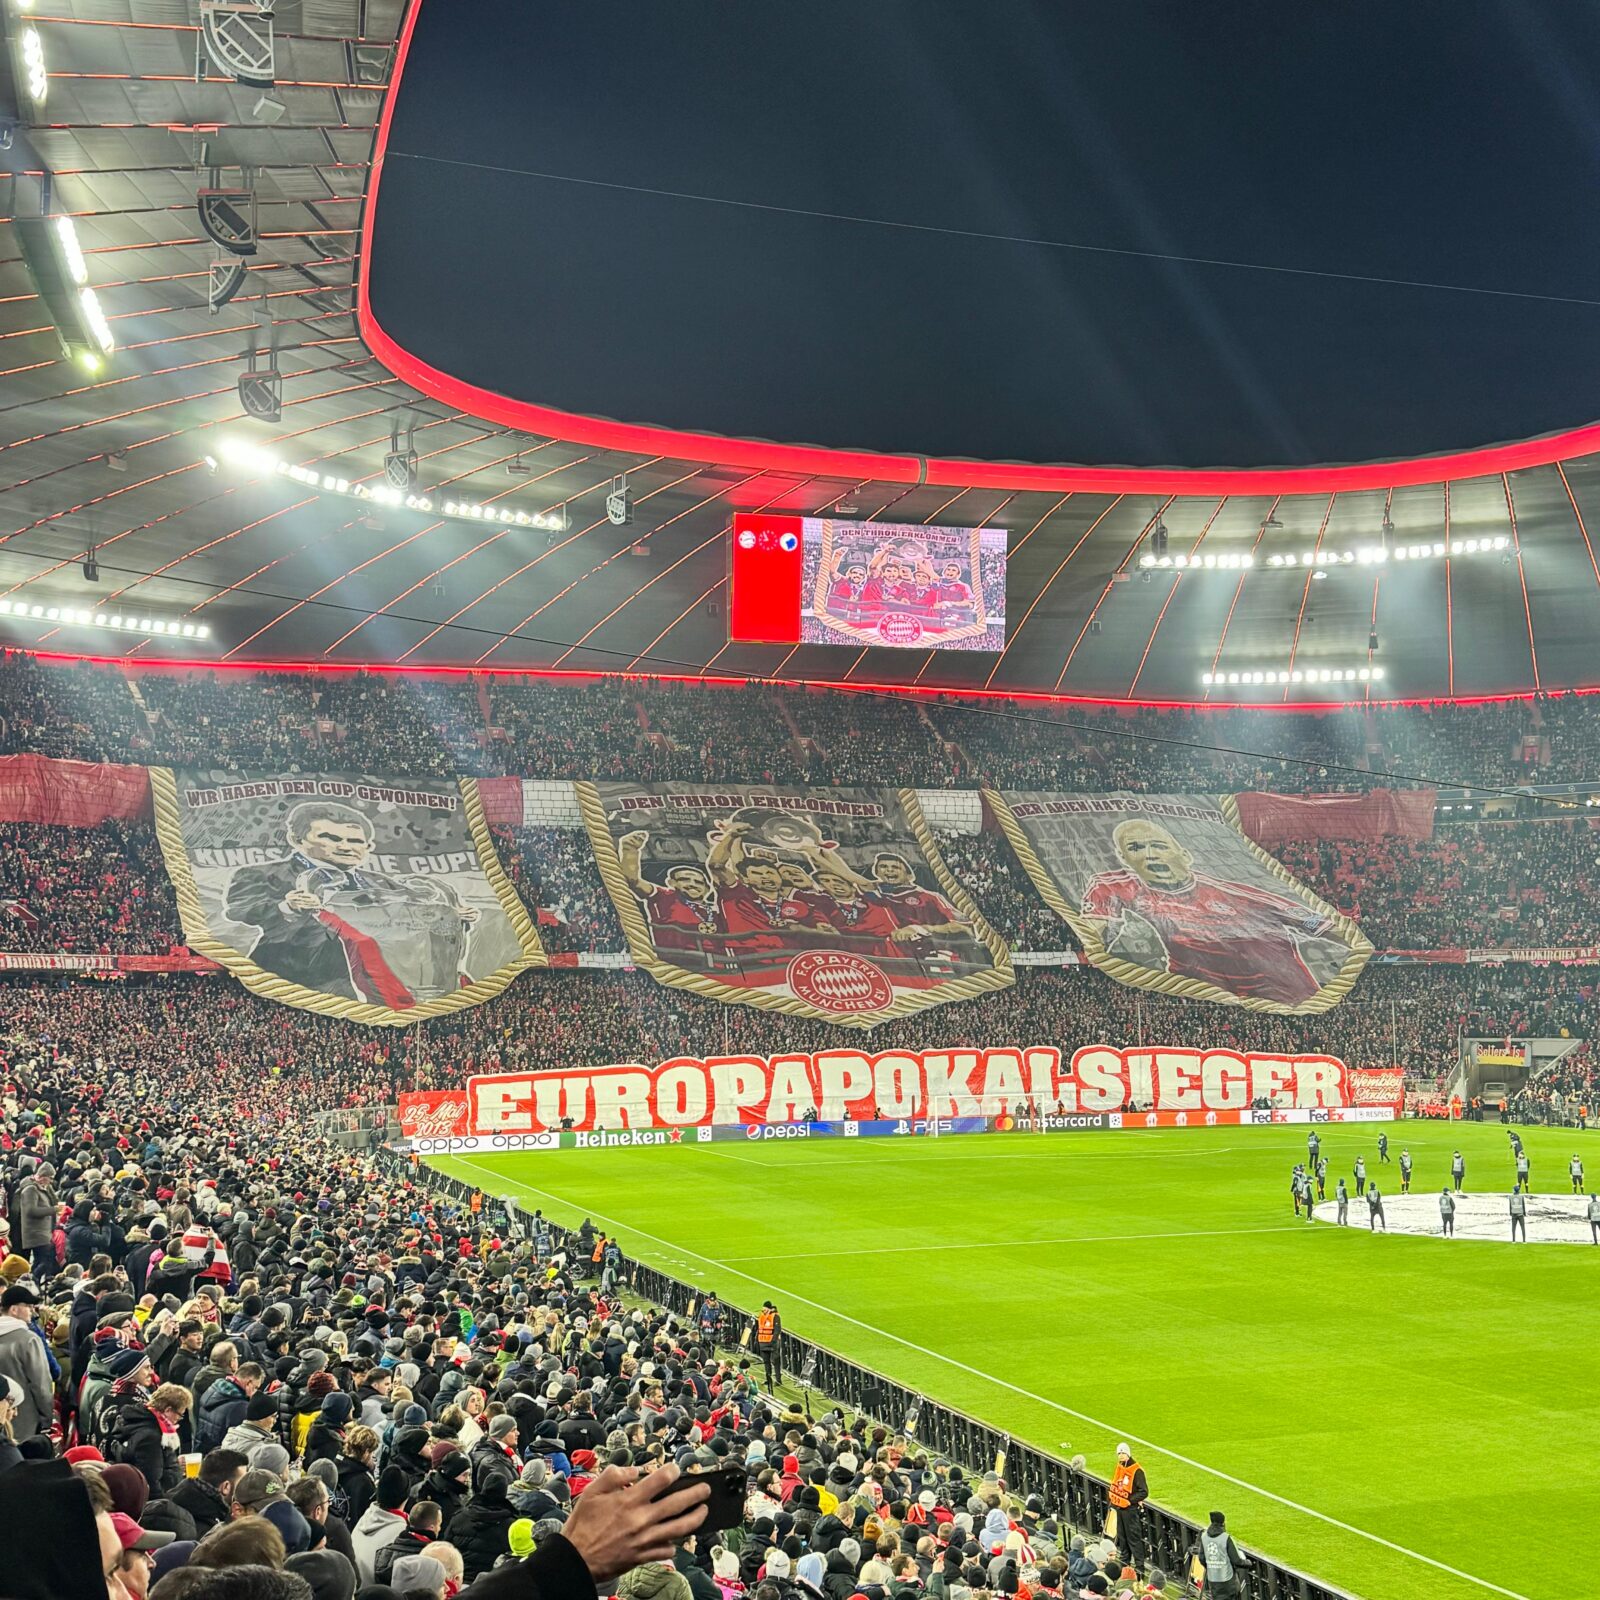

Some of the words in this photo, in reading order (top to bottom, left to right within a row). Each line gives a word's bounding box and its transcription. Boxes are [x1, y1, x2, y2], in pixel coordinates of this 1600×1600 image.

[186, 790, 219, 807] WIR
[221, 782, 278, 801] HABEN
[281, 780, 316, 794] DEN
[320, 782, 353, 796] CUP
[358, 786, 456, 810] GEWONNEN!
[621, 796, 665, 810] DEN
[669, 795, 744, 809] THRON
[754, 796, 882, 817] ERKLOMMEN!
[1011, 803, 1043, 818] DER
[1091, 800, 1140, 812] HAT'S
[1142, 801, 1224, 825] GEMACHT!
[194, 847, 283, 866] KINGS
[408, 851, 480, 874] CUP!
[1511, 949, 1576, 961] WALDKIRCHEN
[812, 955, 878, 979] BAYERN
[1350, 1072, 1402, 1090] Wembley
[475, 1051, 1343, 1132] EUROPAPOKALSIEGER
[1355, 1087, 1401, 1101] Stadion
[431, 1101, 467, 1120] Mai
[1251, 1110, 1288, 1123] FedEx
[1309, 1108, 1345, 1122] FedEx
[1366, 1110, 1392, 1118] RESPECT
[416, 1120, 453, 1137] 2013
[764, 1121, 811, 1140] pepsi
[1017, 1114, 1103, 1129] mastercard
[419, 1137, 479, 1153] oppo
[492, 1132, 552, 1150] oppo
[575, 1128, 666, 1148] Heineken
